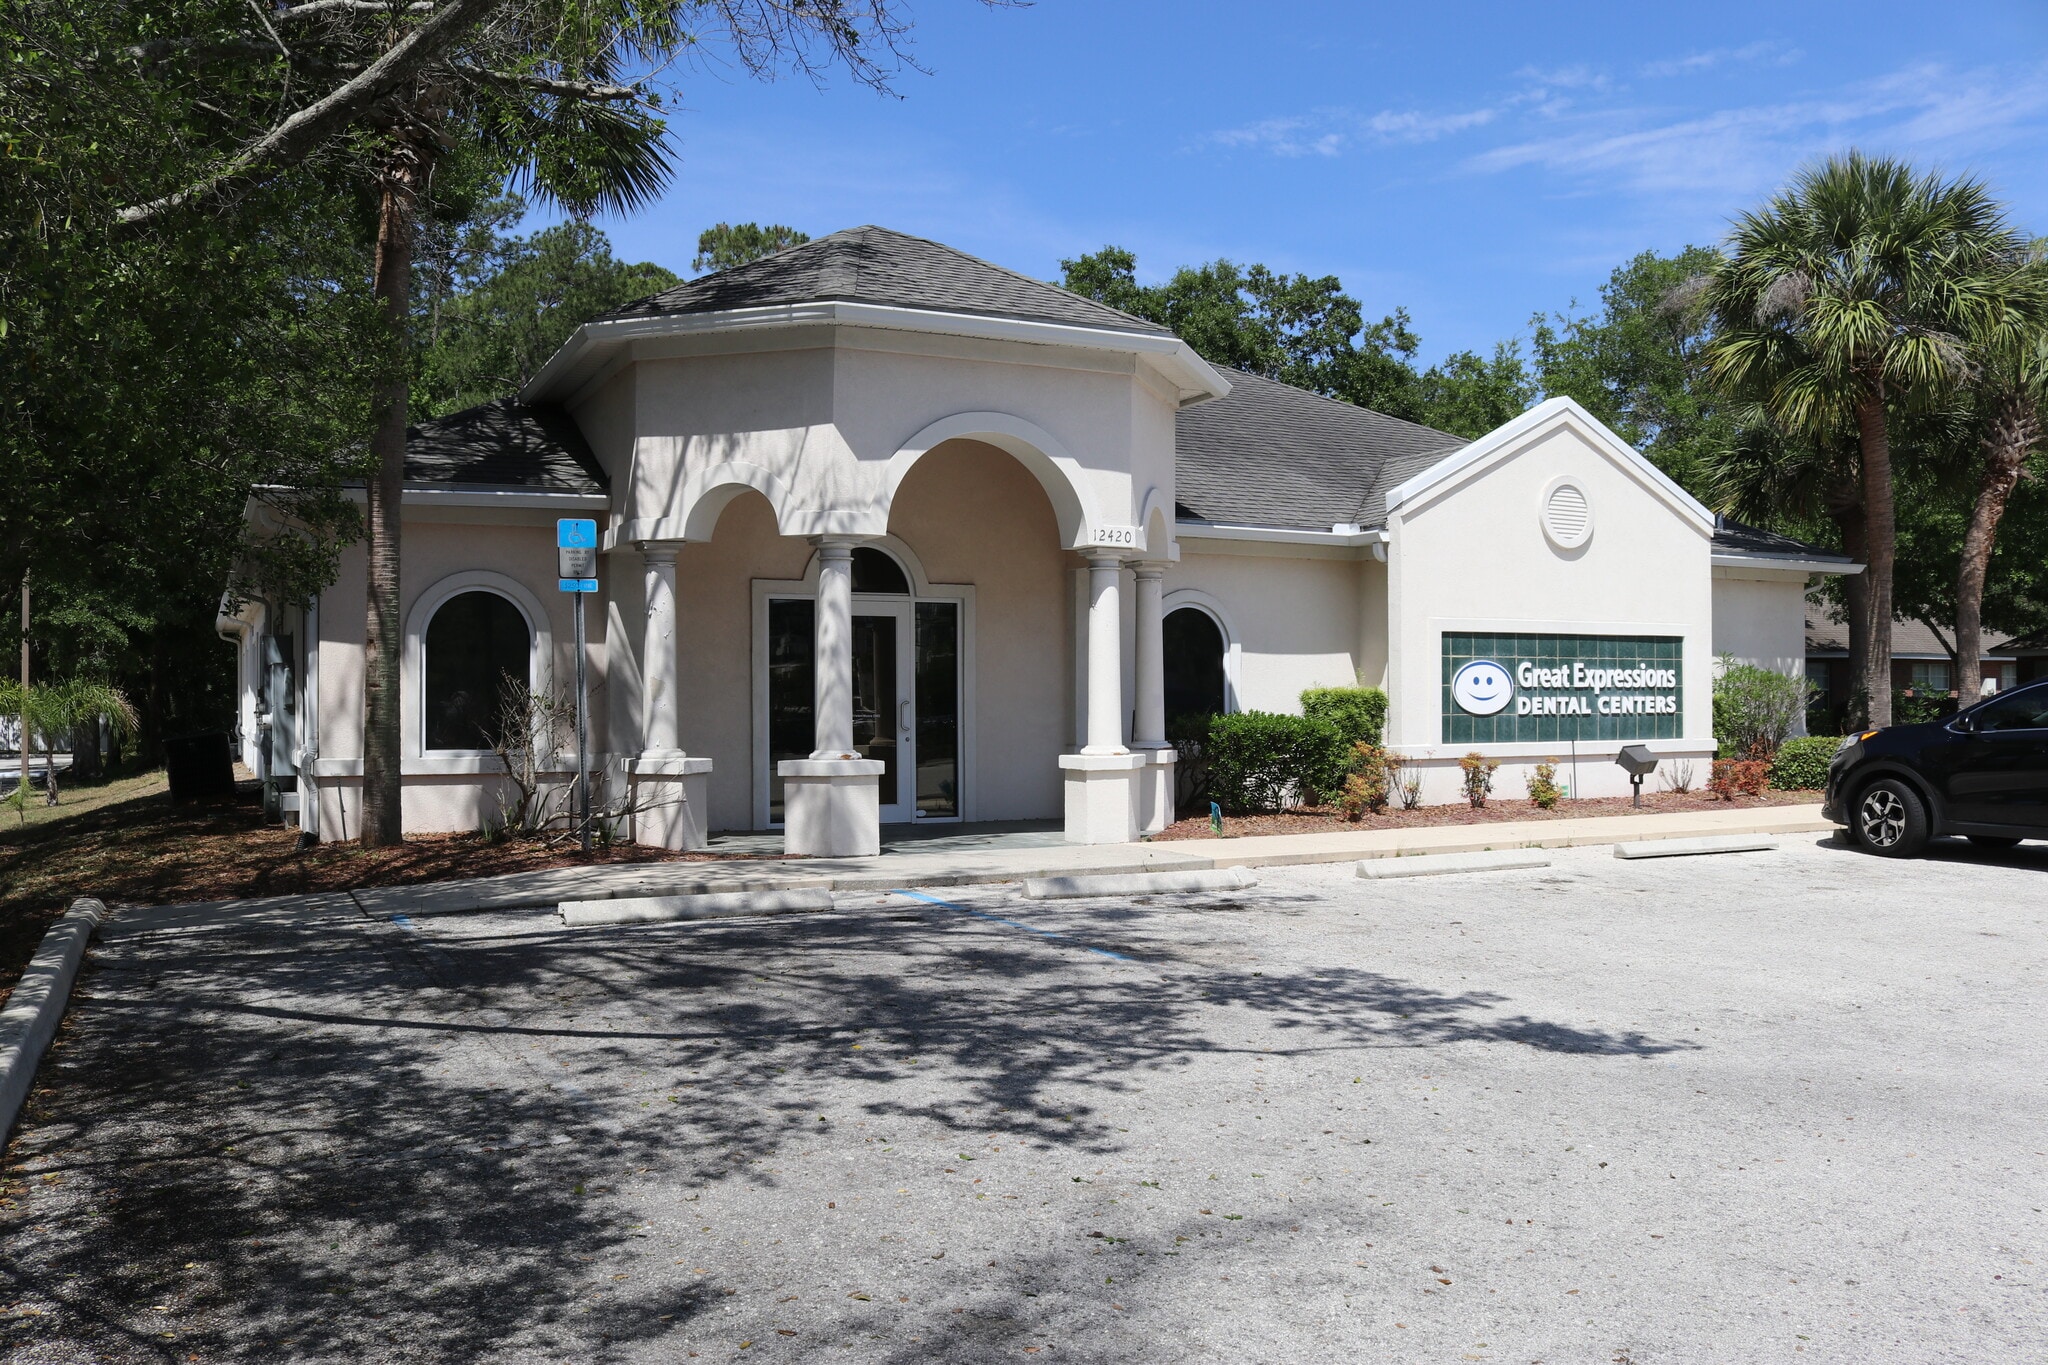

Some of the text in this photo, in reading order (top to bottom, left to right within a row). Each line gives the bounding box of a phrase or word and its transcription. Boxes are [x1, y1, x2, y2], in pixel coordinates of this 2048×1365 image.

[1093, 528, 1132, 544] 12420
[1517, 661, 1676, 695] Great Expressions
[1517, 695, 1677, 715] DENTAL CENTERS
